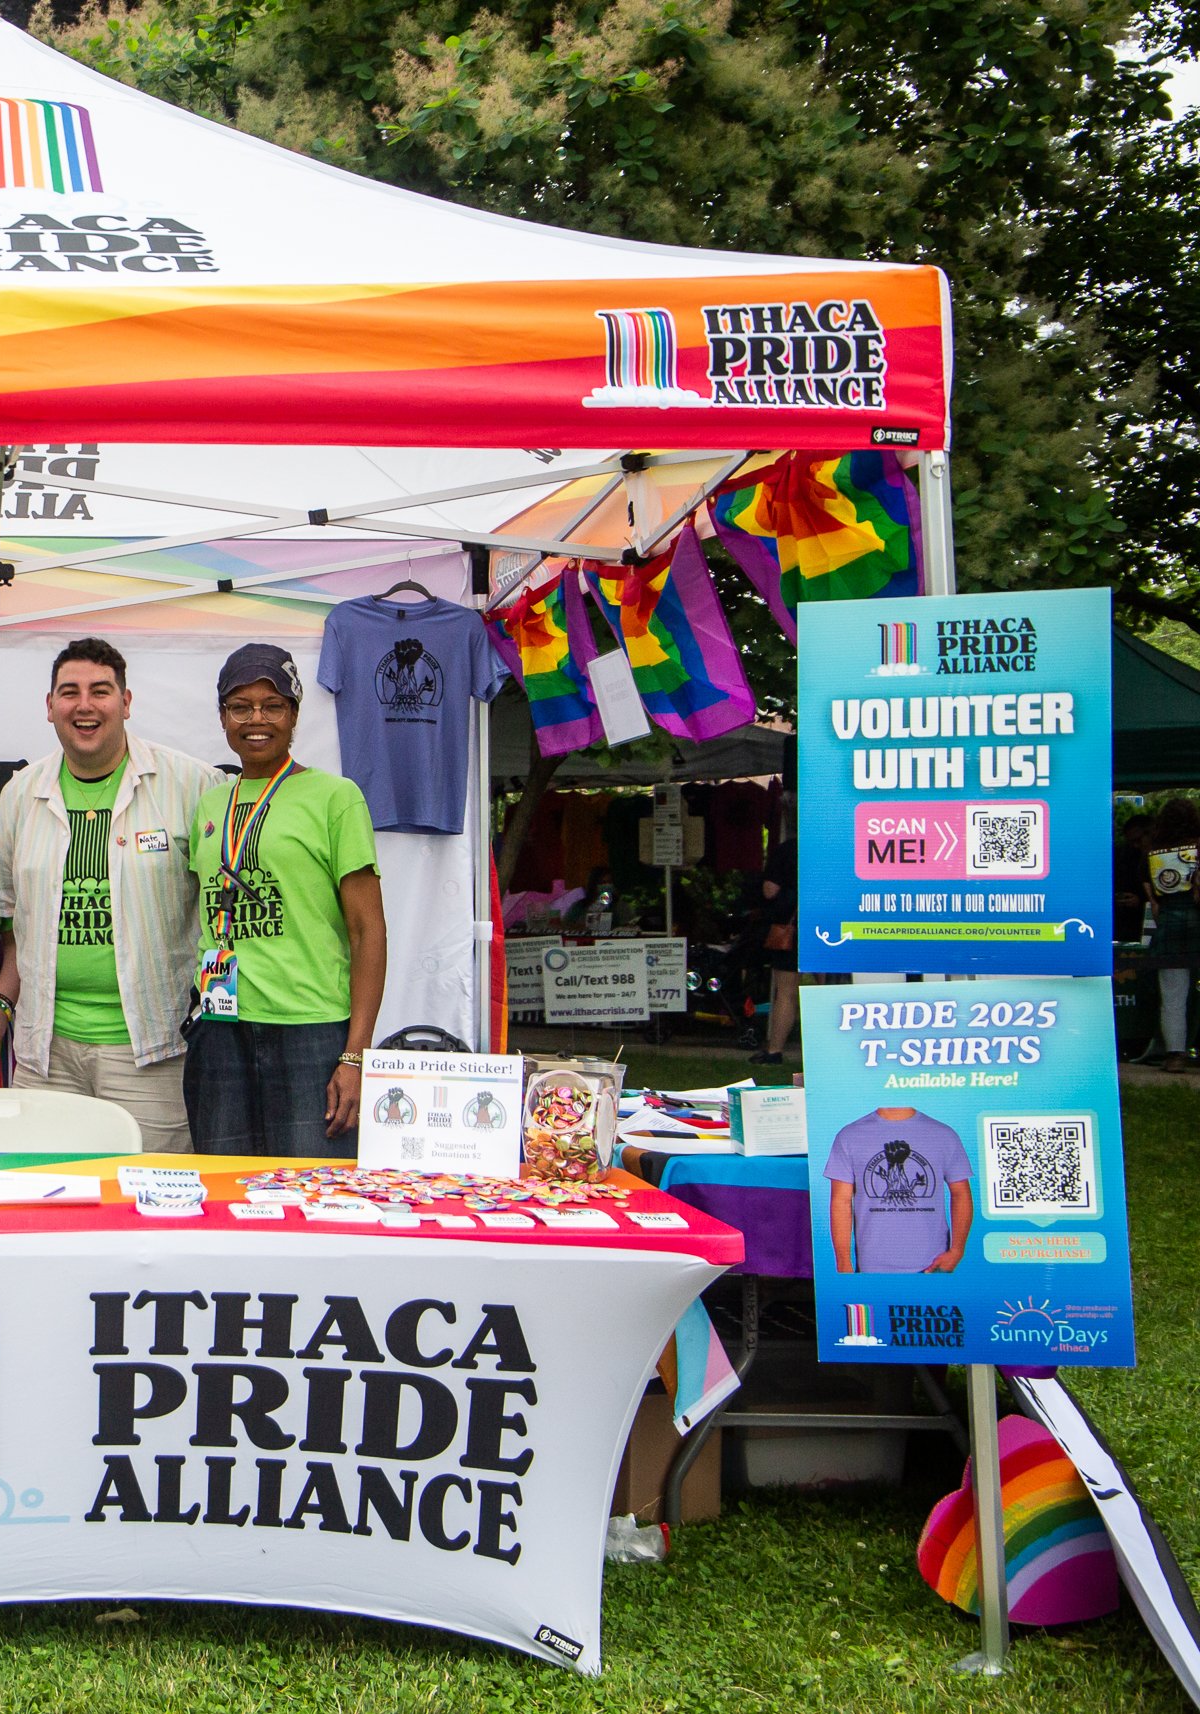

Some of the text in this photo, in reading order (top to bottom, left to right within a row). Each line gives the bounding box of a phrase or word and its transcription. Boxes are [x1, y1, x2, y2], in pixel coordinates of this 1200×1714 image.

[703, 302, 880, 335] ITHACA
[709, 335, 885, 377] PRIDE
[713, 376, 884, 408] ALLIANCE
[886, 431, 918, 441] STRIKE
[936, 617, 1036, 636] ITHACA
[937, 633, 1037, 657] PRIDE
[378, 653, 394, 674] ITHACA
[423, 653, 439, 669] PRIDE
[936, 655, 1036, 675] ALLIANCE
[831, 692, 1075, 739] VOLUNTEER
[853, 745, 1050, 789] WITH US!
[867, 818, 926, 835] SCAN
[867, 839, 926, 864] ME!
[206, 886, 282, 905] ITACA
[859, 894, 1045, 912] JOIN US TO INVEST IN OUR COMMUNITY
[862, 927, 1041, 936] ITHACAPRIDEALLIANCE.ORG/VOLUNTEER
[206, 961, 231, 975] KIM
[555, 975, 609, 987] Call/Text
[612, 973, 635, 984] 988
[621, 990, 636, 998] 24/7
[550, 1006, 644, 1017] www.ithacacrisis.org
[839, 1000, 1059, 1031] PRIDE 2025
[860, 1036, 1041, 1067] T-SHIRTS
[371, 1059, 404, 1070] Grab
[420, 1060, 456, 1072] Pride
[459, 1062, 512, 1074] Sticker!
[884, 1072, 1019, 1089] Available Here!
[432, 1150, 481, 1160] Donation $2
[434, 1142, 476, 1152] Suggested
[1009, 1236, 1080, 1245] SCAN HERE
[1001, 1249, 1090, 1258] TO PURCHASE!
[888, 1305, 963, 1317] ITHACA
[89, 1289, 537, 1373] ITHACA
[889, 1317, 965, 1333] PRIDE
[890, 1333, 965, 1347] ALLIANCE
[991, 1324, 1108, 1347] Sunny Days
[1059, 1343, 1090, 1352] Ithaca
[92, 1361, 538, 1478] PRIDE
[84, 1453, 522, 1567] ALLIANCE
[550, 1635, 581, 1655] STRIKE
